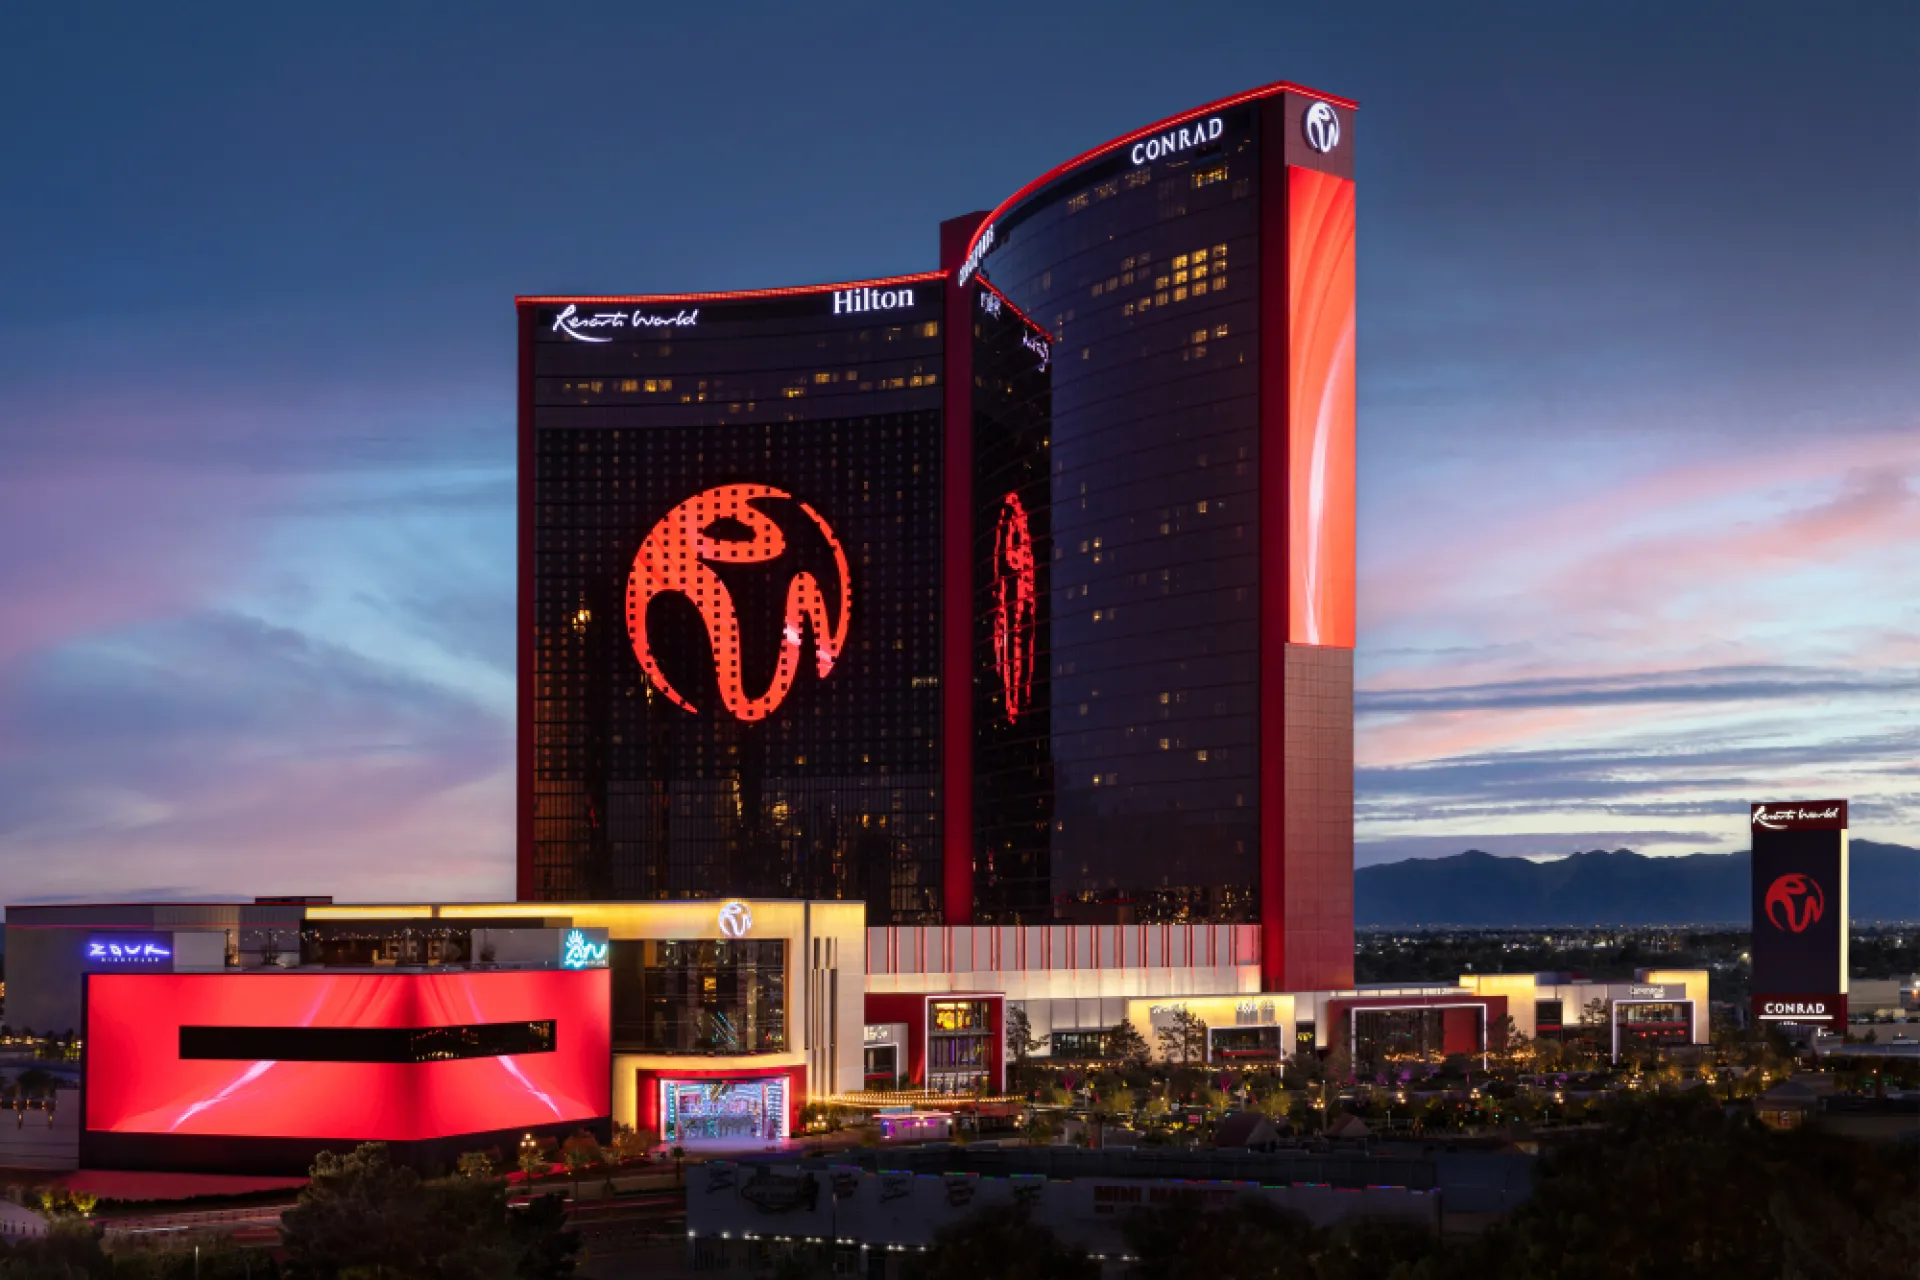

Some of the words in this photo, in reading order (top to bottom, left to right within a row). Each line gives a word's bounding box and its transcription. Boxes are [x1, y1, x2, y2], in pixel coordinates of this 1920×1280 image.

[1131, 117, 1223, 165] CONRAD
[833, 287, 914, 313] Hilton
[552, 303, 629, 342] Resorts
[632, 308, 700, 327] World
[1764, 1003, 1825, 1014] CONRAD
